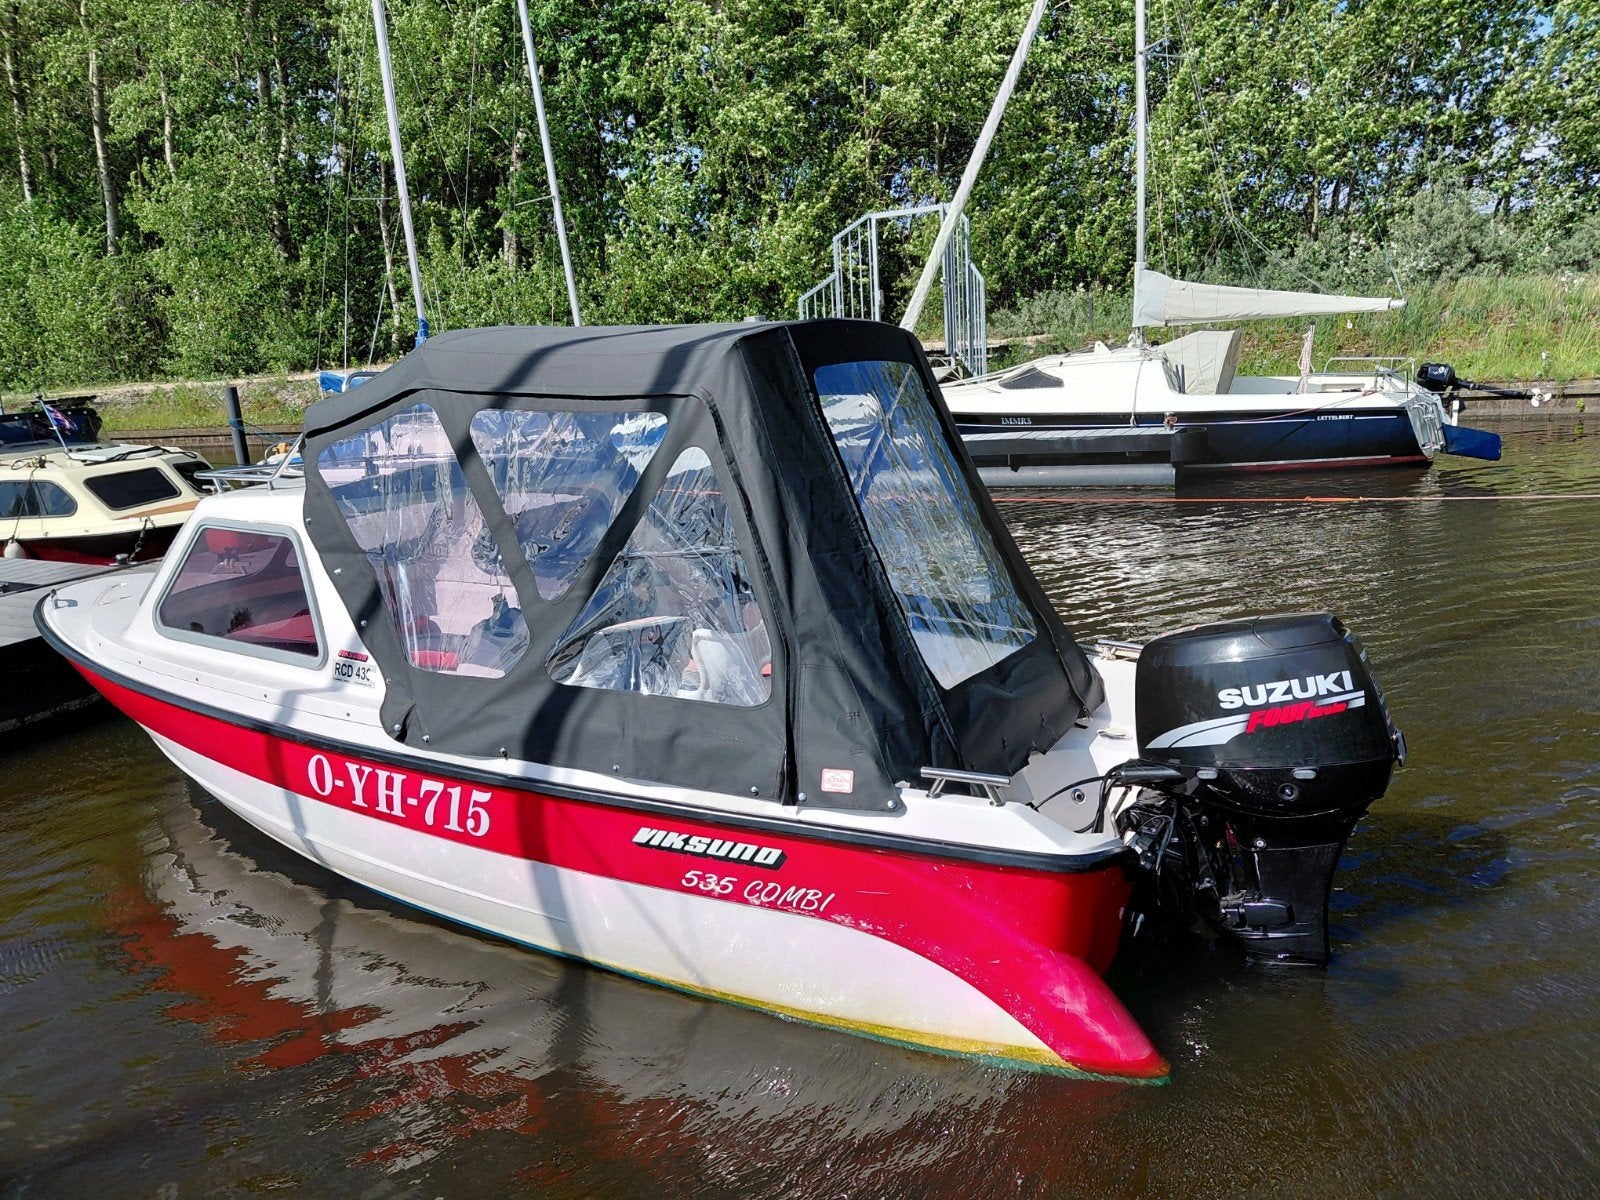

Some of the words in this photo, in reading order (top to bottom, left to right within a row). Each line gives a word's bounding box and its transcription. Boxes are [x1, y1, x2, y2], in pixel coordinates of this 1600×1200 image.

[334, 662, 354, 677] RCD
[1218, 670, 1354, 709] SUZUKI
[308, 754, 492, 837] O-YH-715
[681, 870, 738, 895] 535
[743, 880, 836, 912] COMBI
